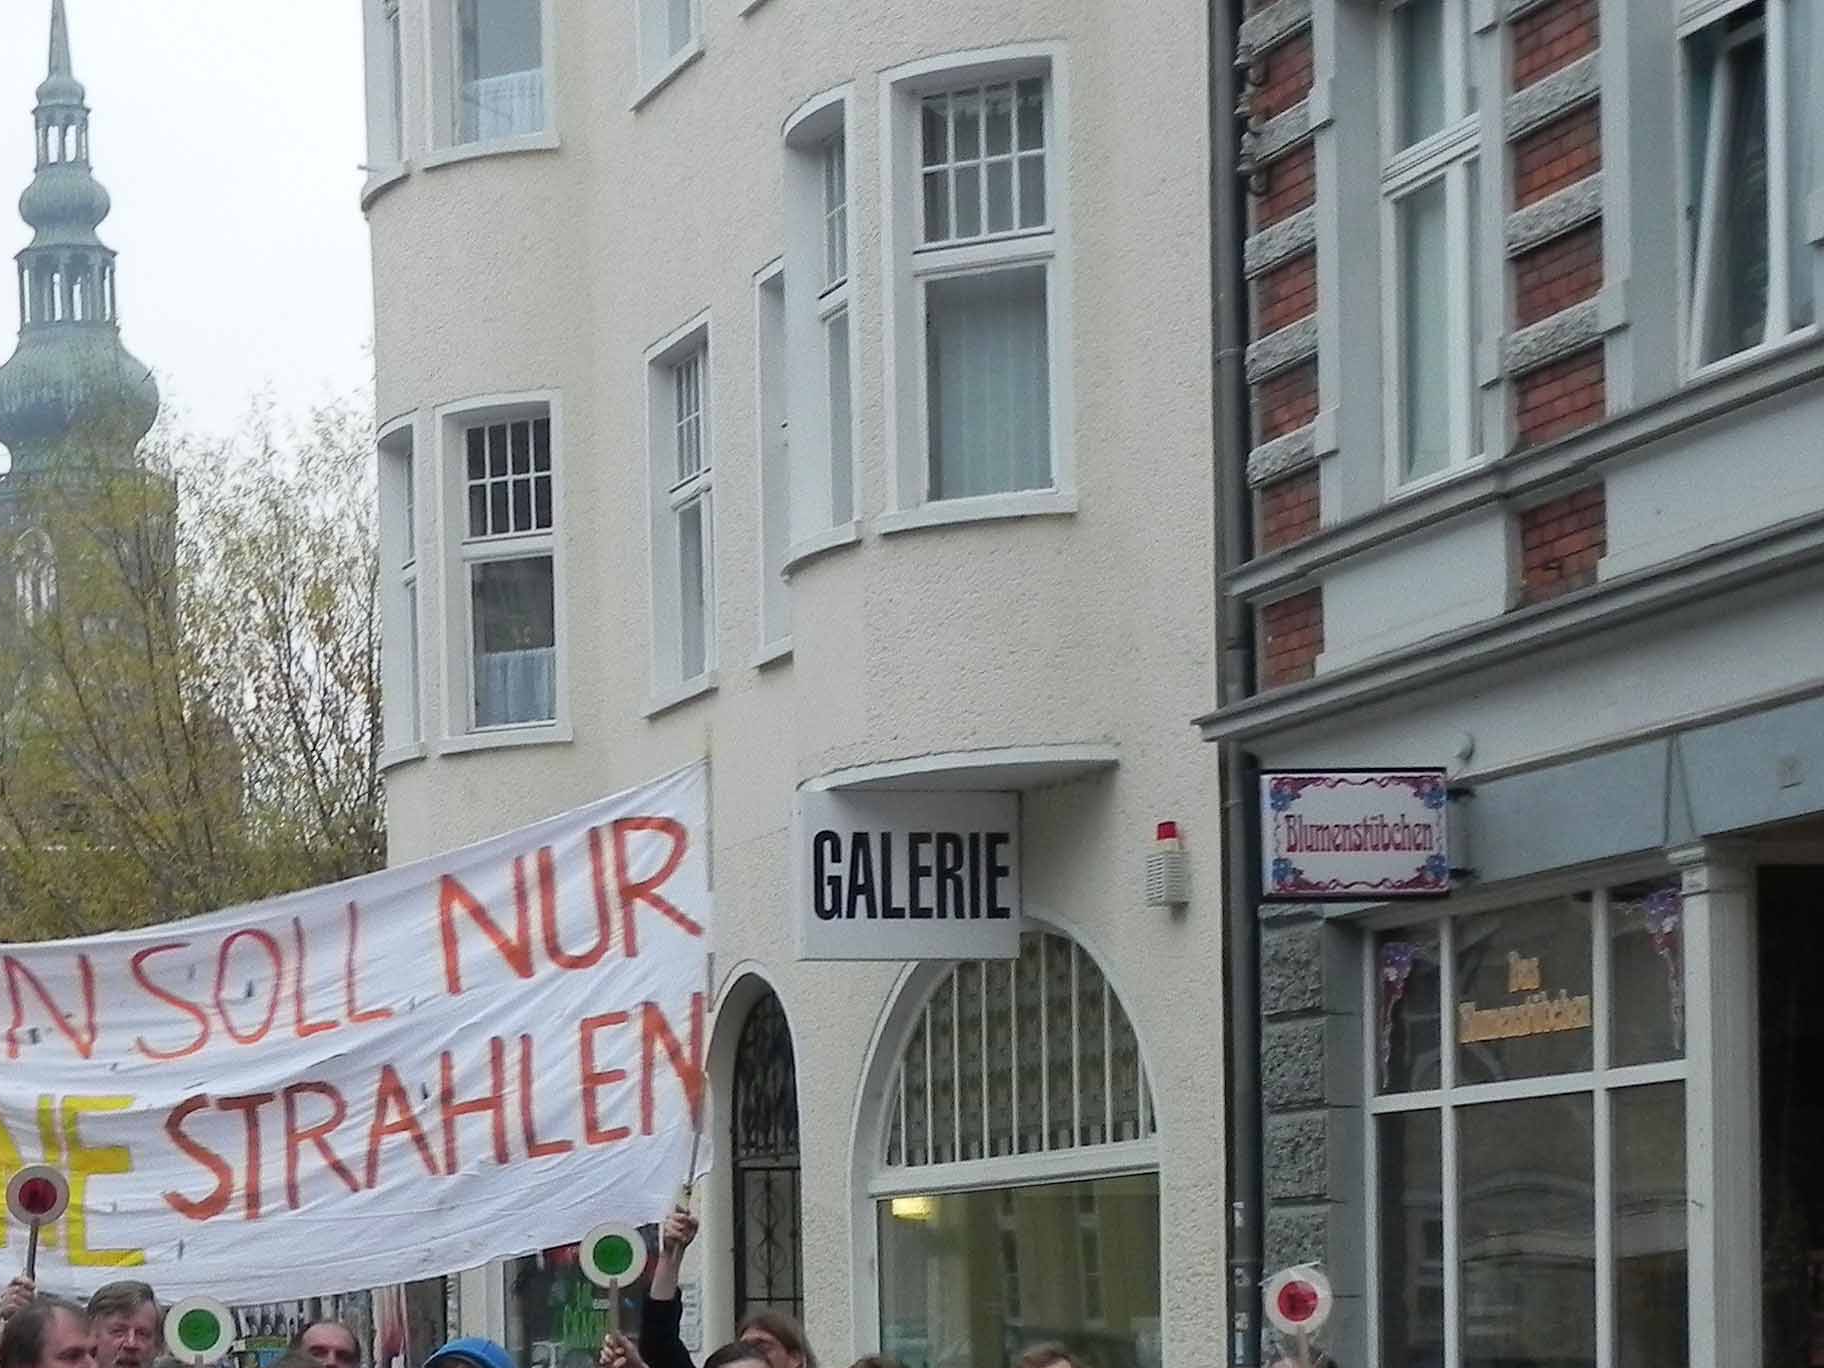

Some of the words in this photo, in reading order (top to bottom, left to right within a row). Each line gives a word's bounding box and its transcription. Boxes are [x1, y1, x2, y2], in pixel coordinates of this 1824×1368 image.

[813, 830, 1011, 920] GALERIE
[1284, 814, 1434, 853] Blumenstübchen
[131, 900, 394, 1060] SOLL
[438, 816, 704, 996] NUR
[160, 990, 706, 1222] STRAHLEN
